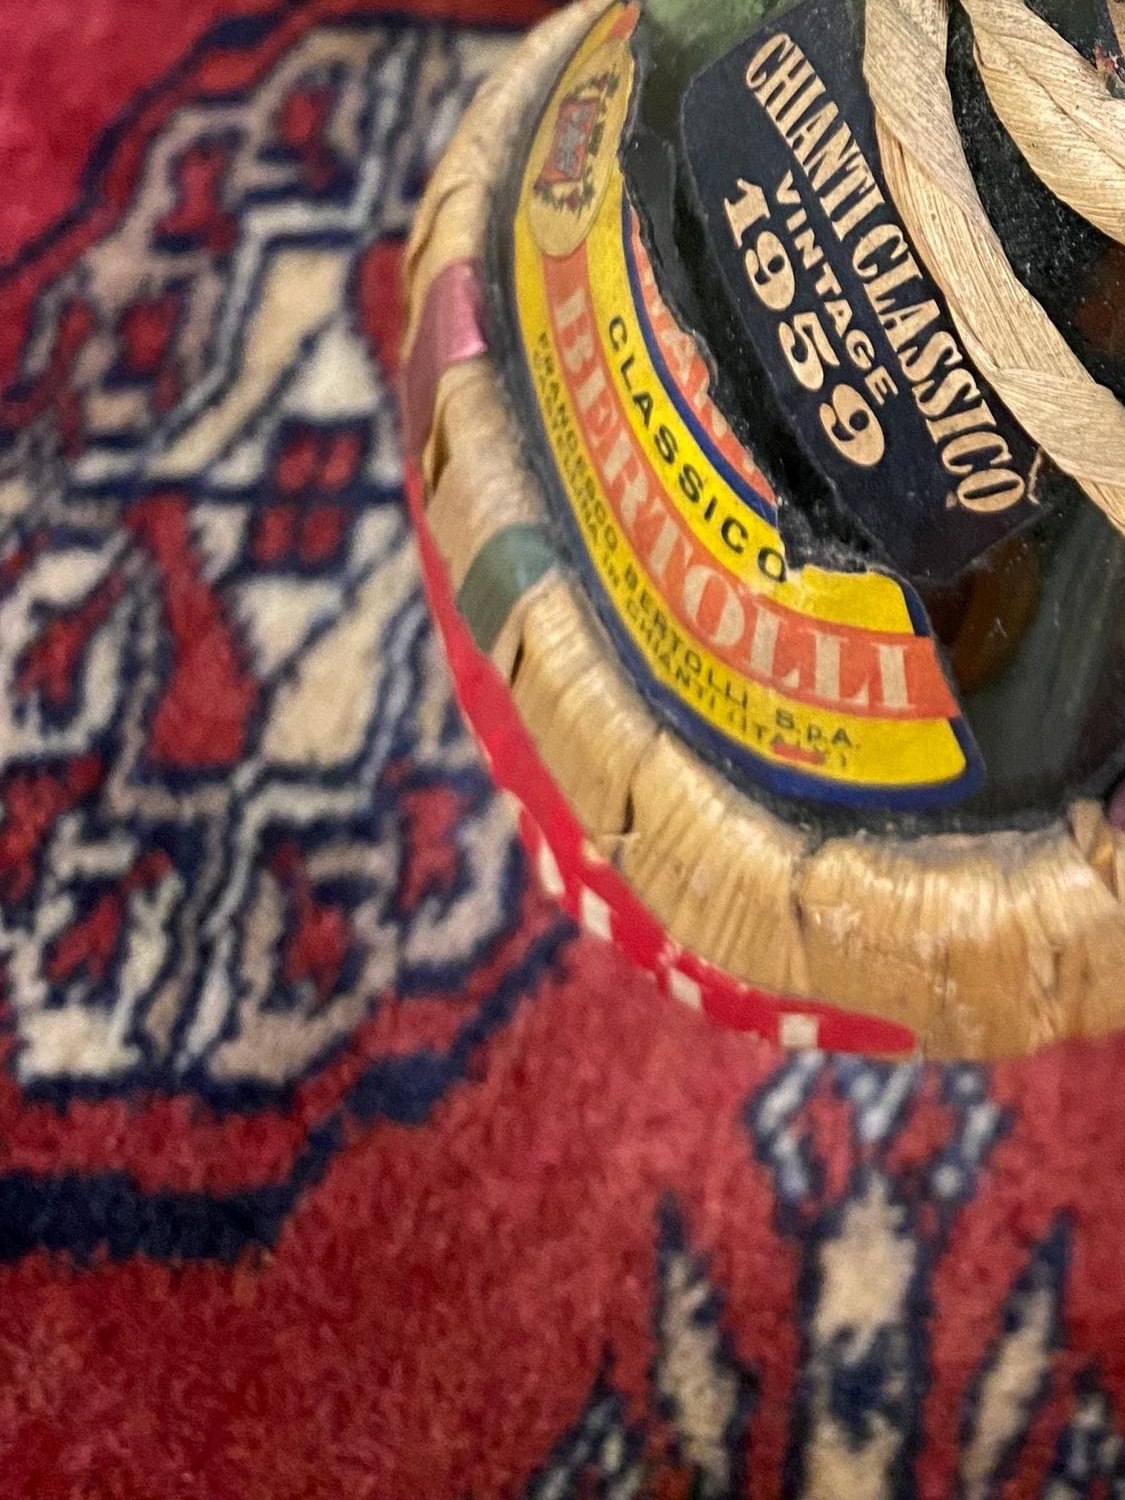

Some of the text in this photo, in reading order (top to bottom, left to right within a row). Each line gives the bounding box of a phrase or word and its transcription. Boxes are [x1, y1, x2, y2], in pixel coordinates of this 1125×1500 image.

[723, 177, 885, 467] 1959
[745, 32, 1027, 512] CHIANTI CLASSICO
[772, 169, 899, 406] VINTAGE
[552, 287, 917, 711] BERTOLLI
[608, 315, 787, 583] CLASSICO
[624, 563, 749, 709] BERTOLLI
